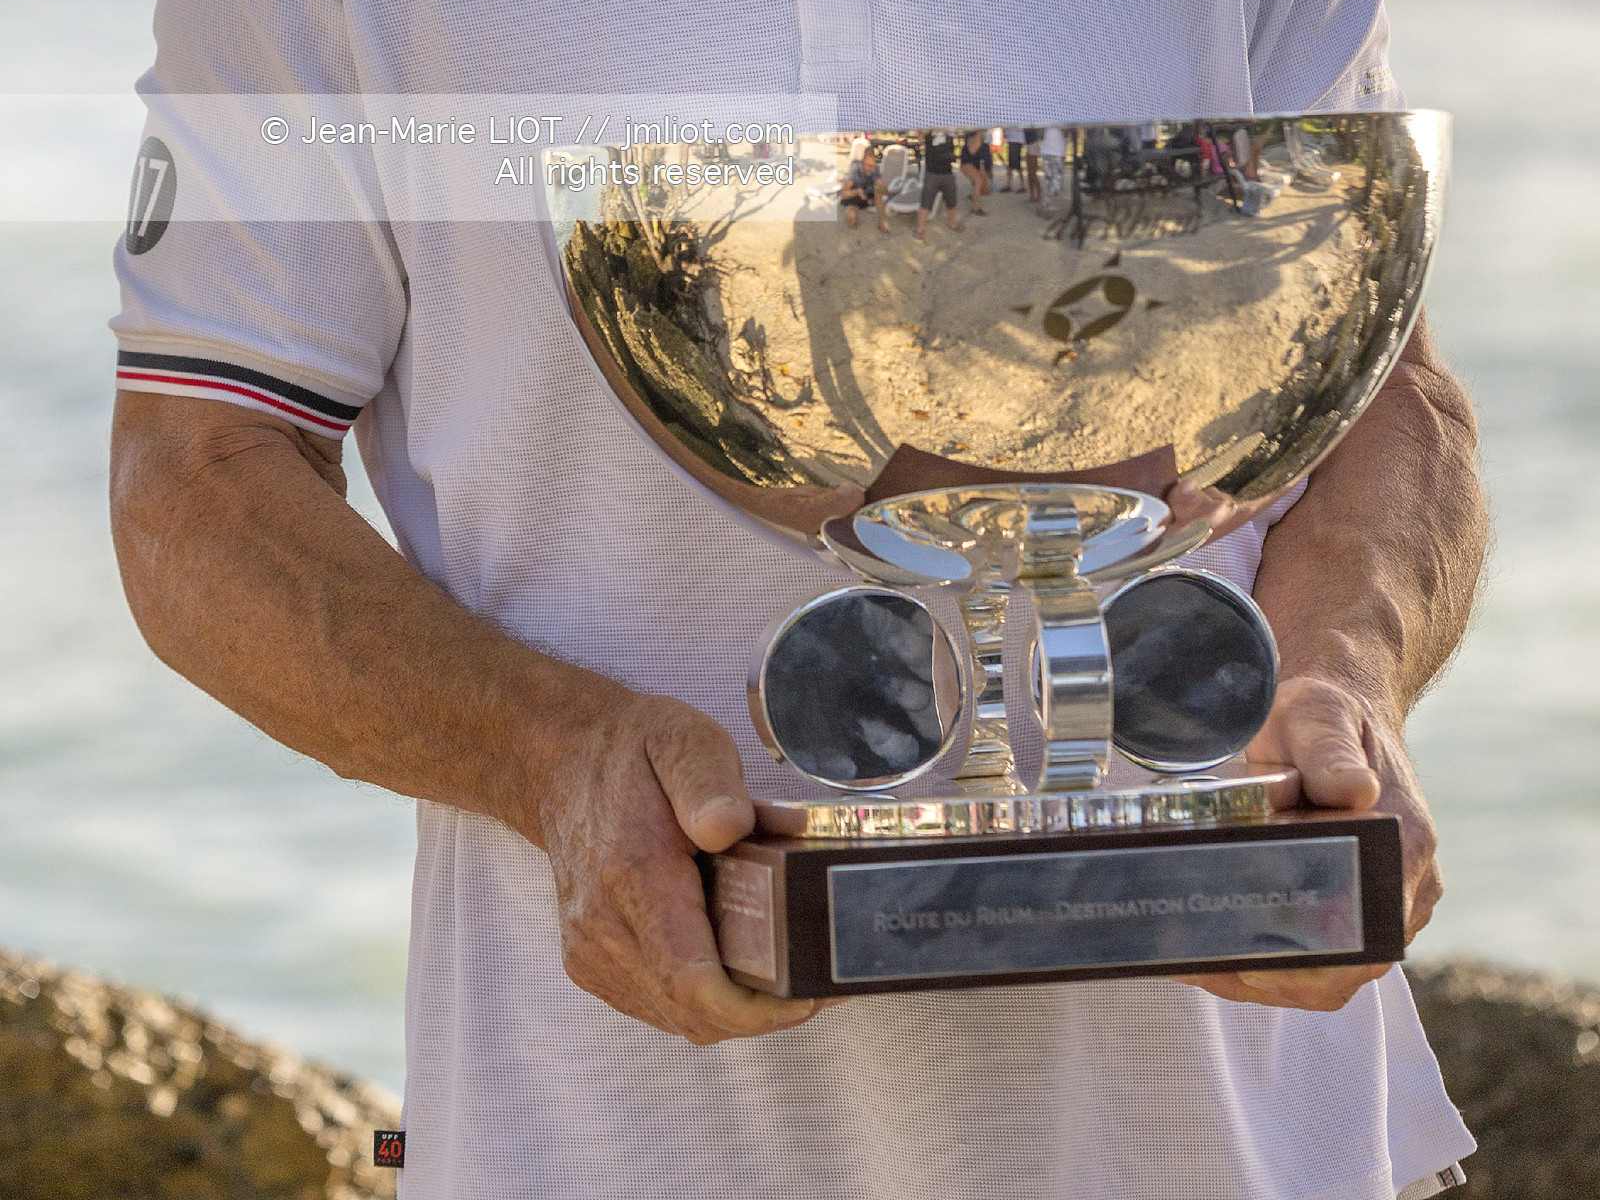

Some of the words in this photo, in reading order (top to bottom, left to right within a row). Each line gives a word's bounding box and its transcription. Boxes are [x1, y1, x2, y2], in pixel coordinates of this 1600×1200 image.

[129, 156, 169, 237] 17
[1053, 899, 1186, 922] DESTINATION
[378, 1140, 402, 1158] 40
